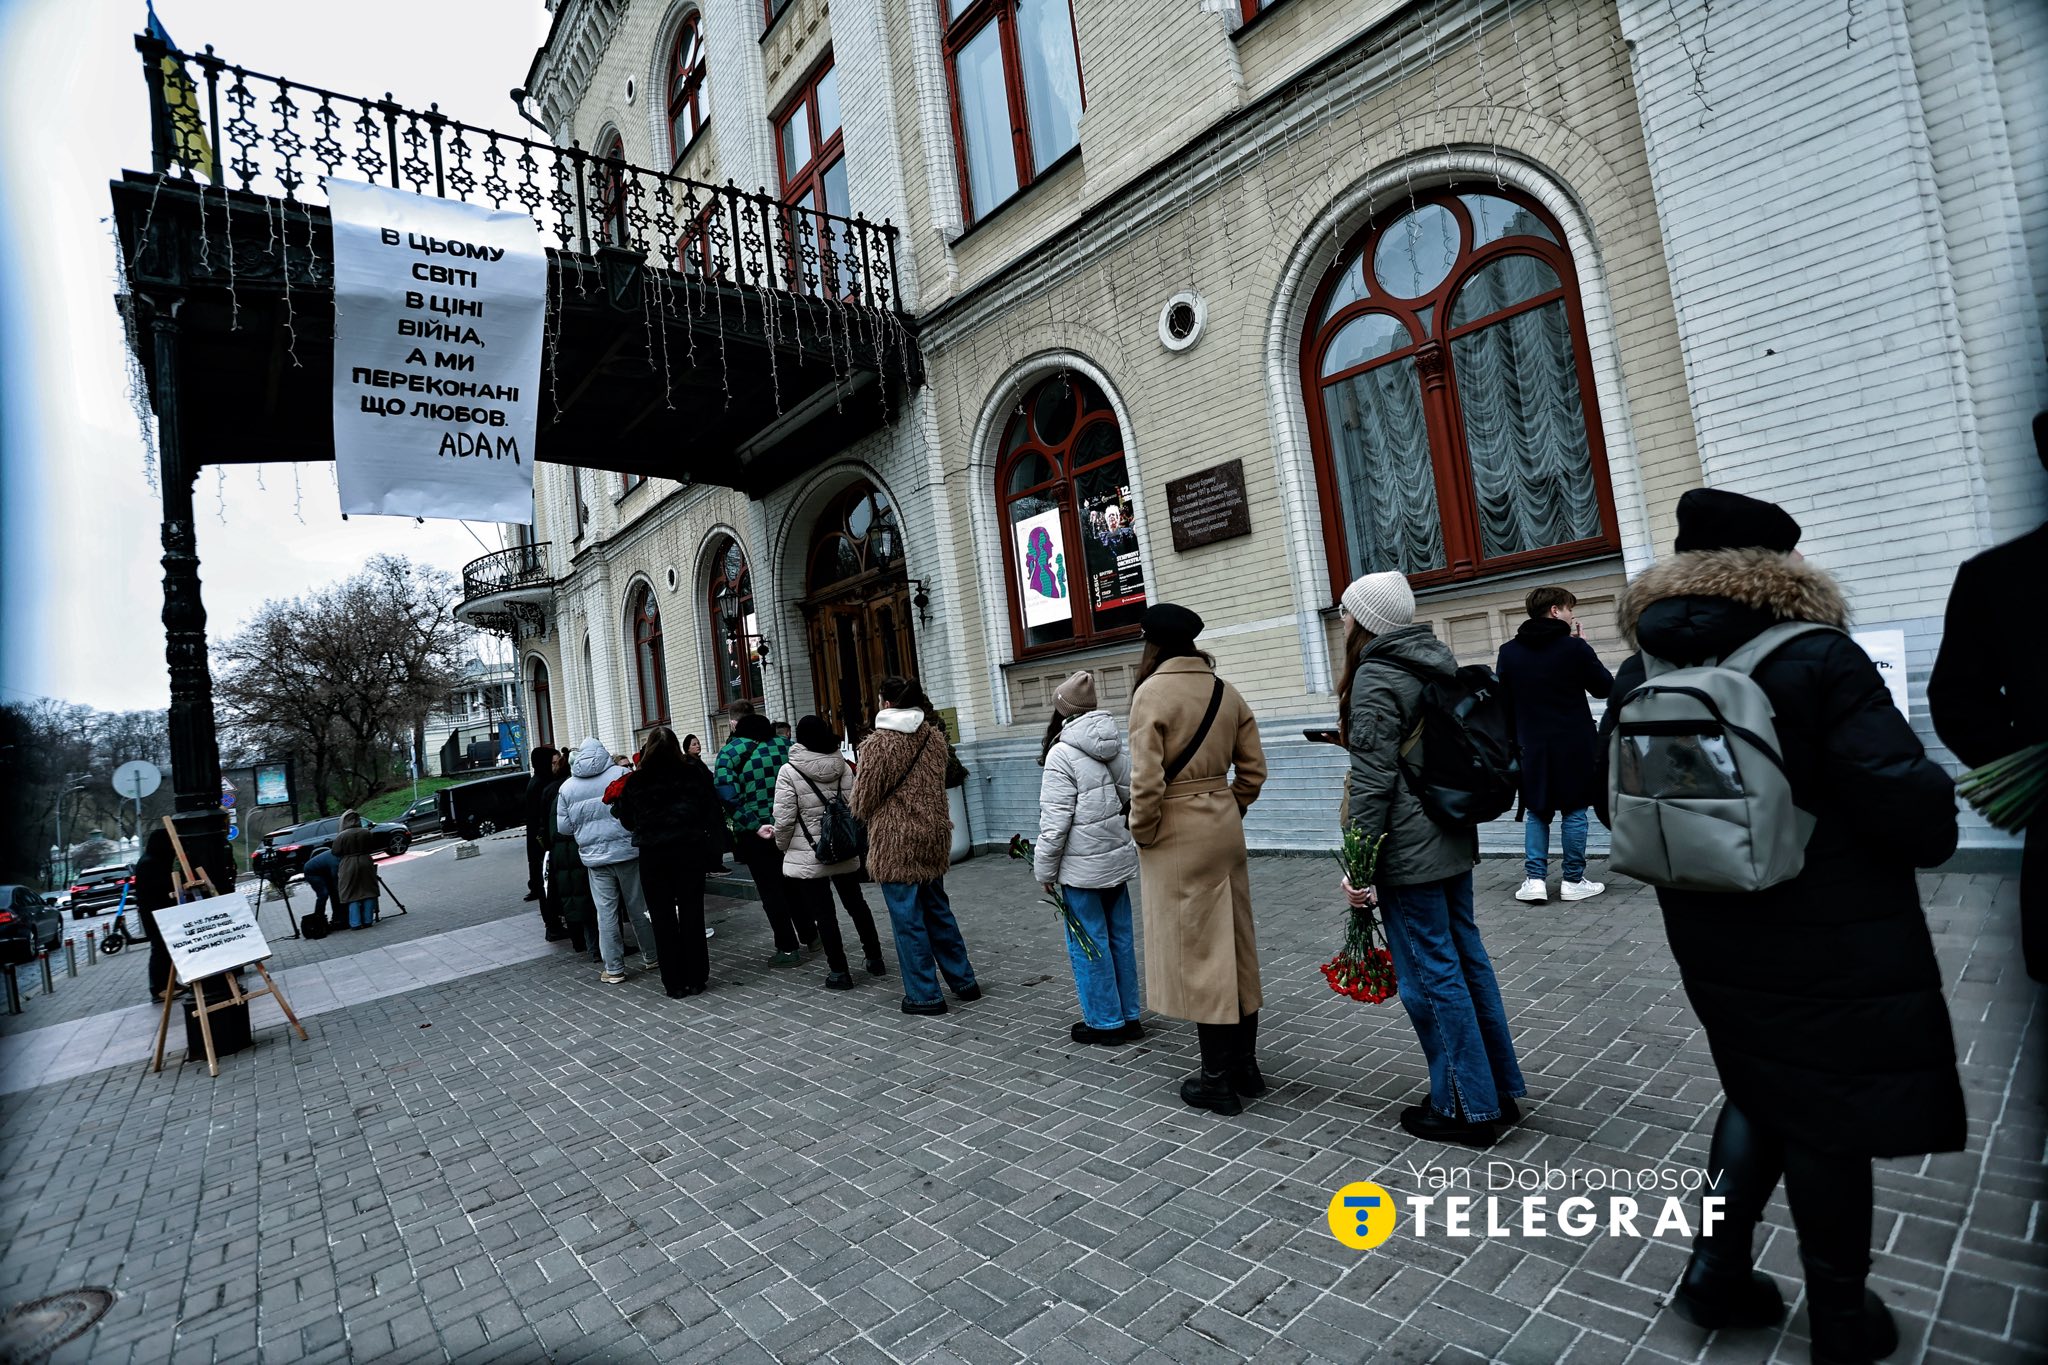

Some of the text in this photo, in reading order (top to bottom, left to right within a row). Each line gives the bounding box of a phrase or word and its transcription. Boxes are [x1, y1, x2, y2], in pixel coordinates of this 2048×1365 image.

[381, 227, 505, 262] В ЦЬОМУ
[411, 262, 477, 288] СВІТІ
[405, 290, 483, 318] В ЦІНІ
[397, 318, 486, 348] ВІЙНА,
[405, 347, 475, 372] А МИ
[352, 366, 520, 403] ПЕРЕКОНАНІ
[360, 394, 509, 427] ЩО ЛЮБОВ.
[438, 431, 521, 465] ADAM
